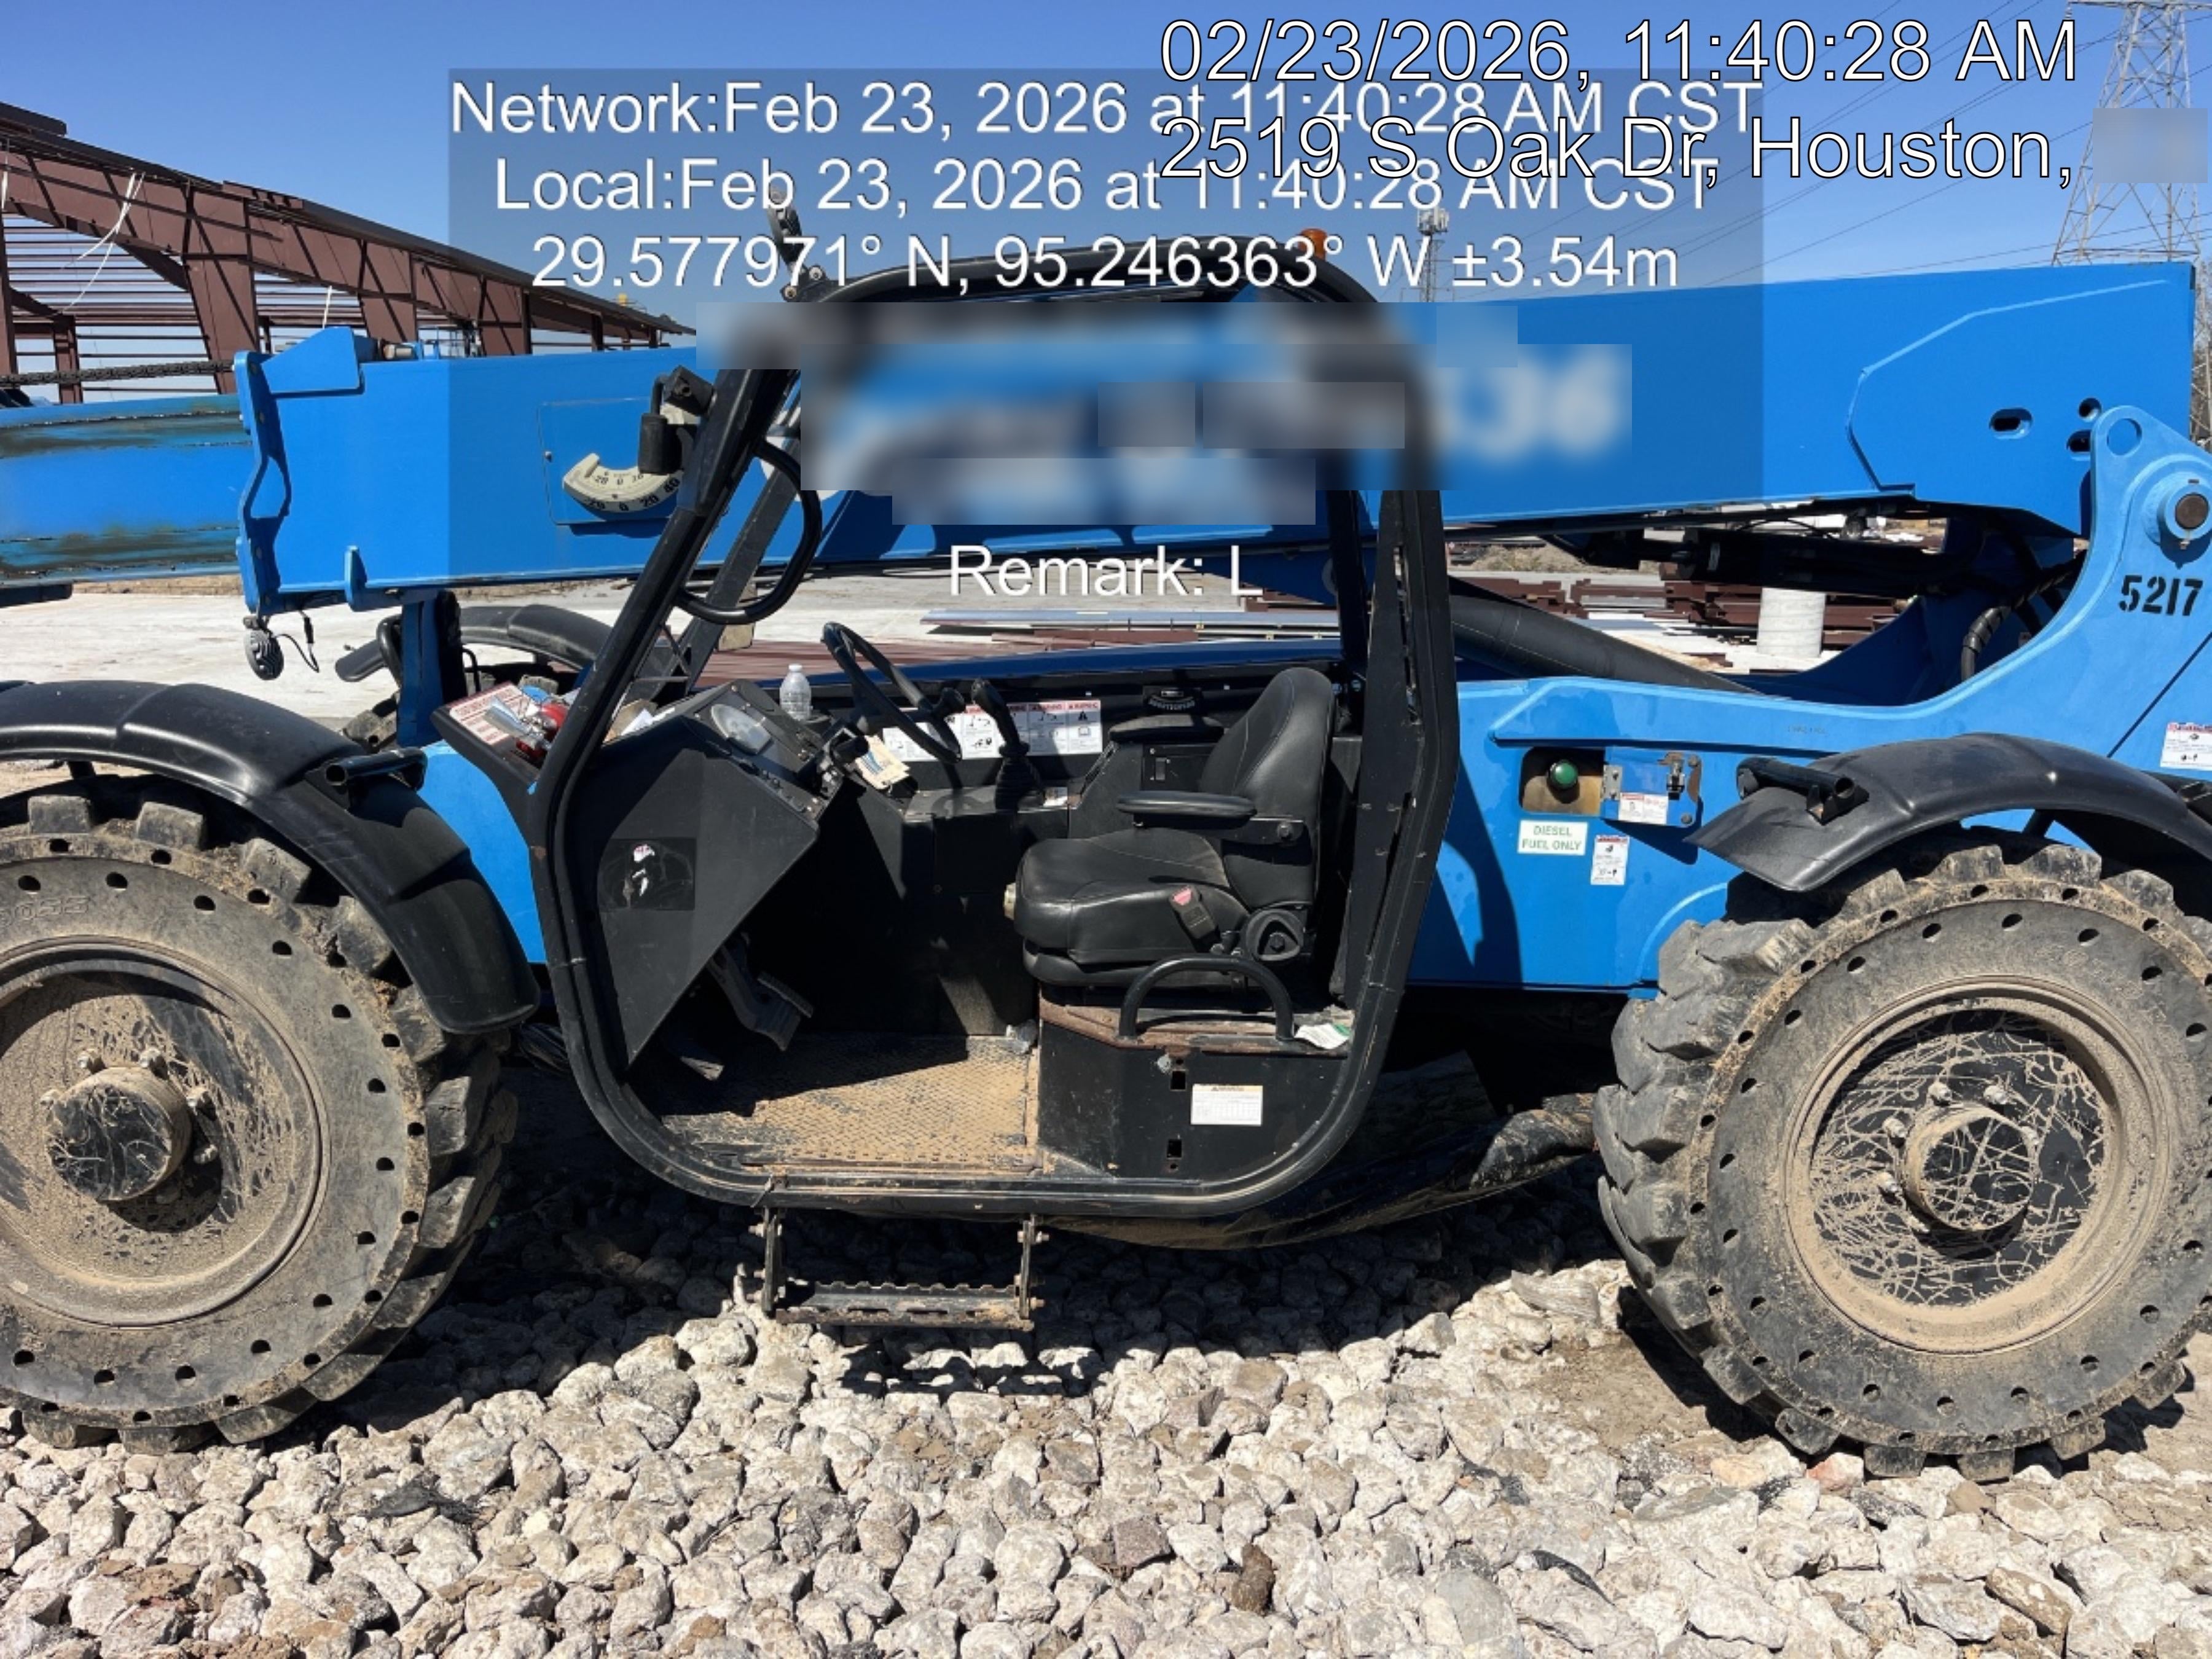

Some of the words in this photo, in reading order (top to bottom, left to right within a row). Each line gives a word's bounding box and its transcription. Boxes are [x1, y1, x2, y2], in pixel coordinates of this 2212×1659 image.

[2118, 575, 2204, 616] 5217
[1533, 825, 1572, 837] DIESEL
[1521, 838, 1549, 850] FUEL
[1551, 840, 1582, 852] ONLY
